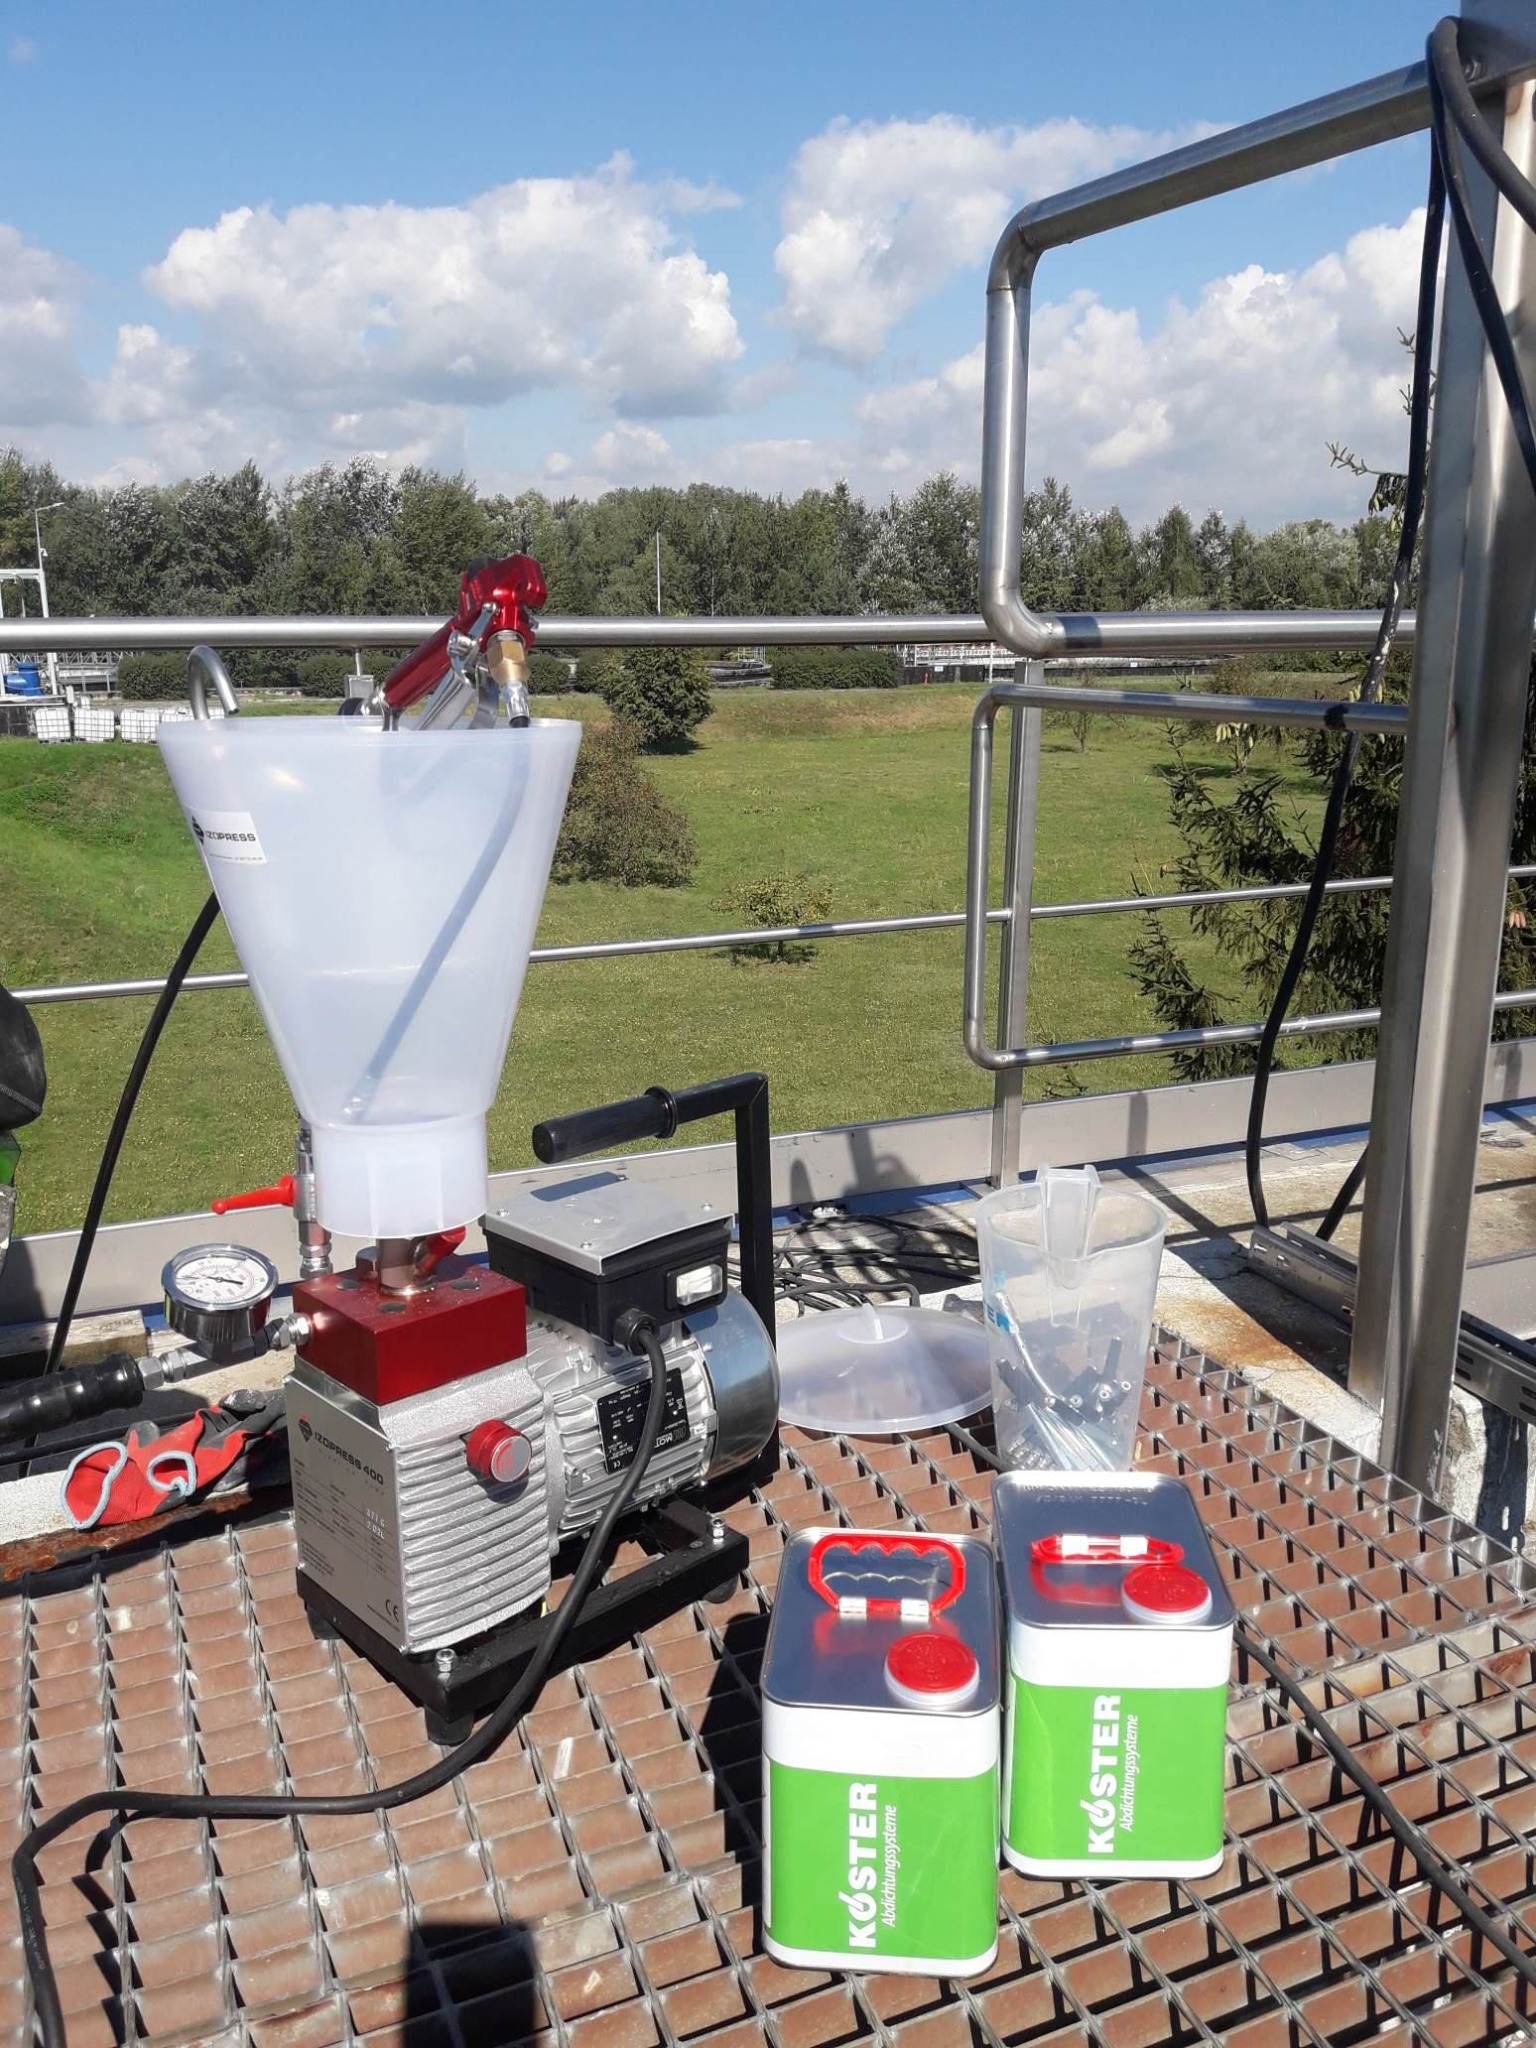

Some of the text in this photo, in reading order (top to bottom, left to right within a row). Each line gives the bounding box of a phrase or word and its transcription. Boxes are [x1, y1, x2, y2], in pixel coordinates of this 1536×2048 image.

[314, 1431, 362, 1471] IZOPRESS
[363, 1465, 384, 1486] 400
[1119, 1714, 1141, 1832] Abdichtungssysteme
[880, 1804, 901, 1928] Abdichtungssysteme
